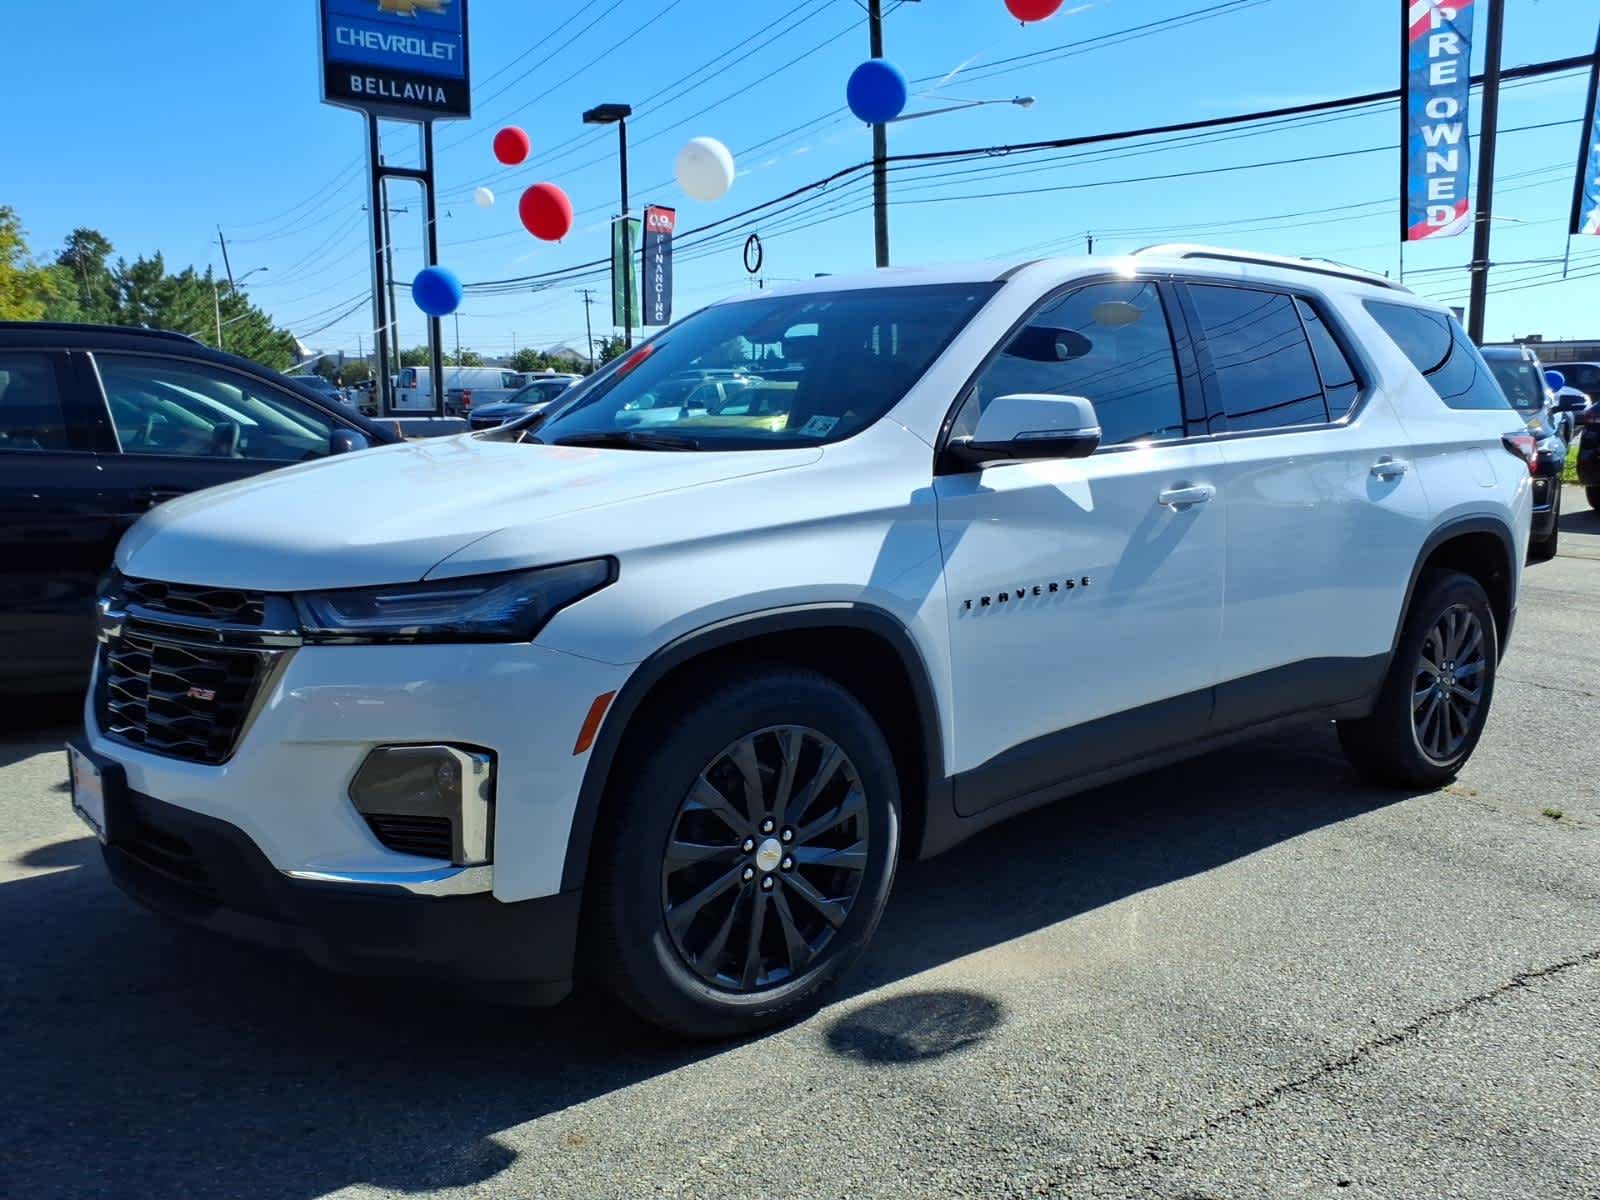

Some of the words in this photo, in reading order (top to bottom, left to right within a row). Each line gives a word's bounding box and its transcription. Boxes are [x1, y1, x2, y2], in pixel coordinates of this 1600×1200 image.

[336, 26, 456, 60] CHEVROLET
[1428, 7, 1460, 86] PRE
[351, 75, 447, 103] BELLAVIA
[1421, 97, 1463, 227] OWNED
[655, 234, 664, 321] FINANCING
[964, 576, 1090, 609] TRAVERSE
